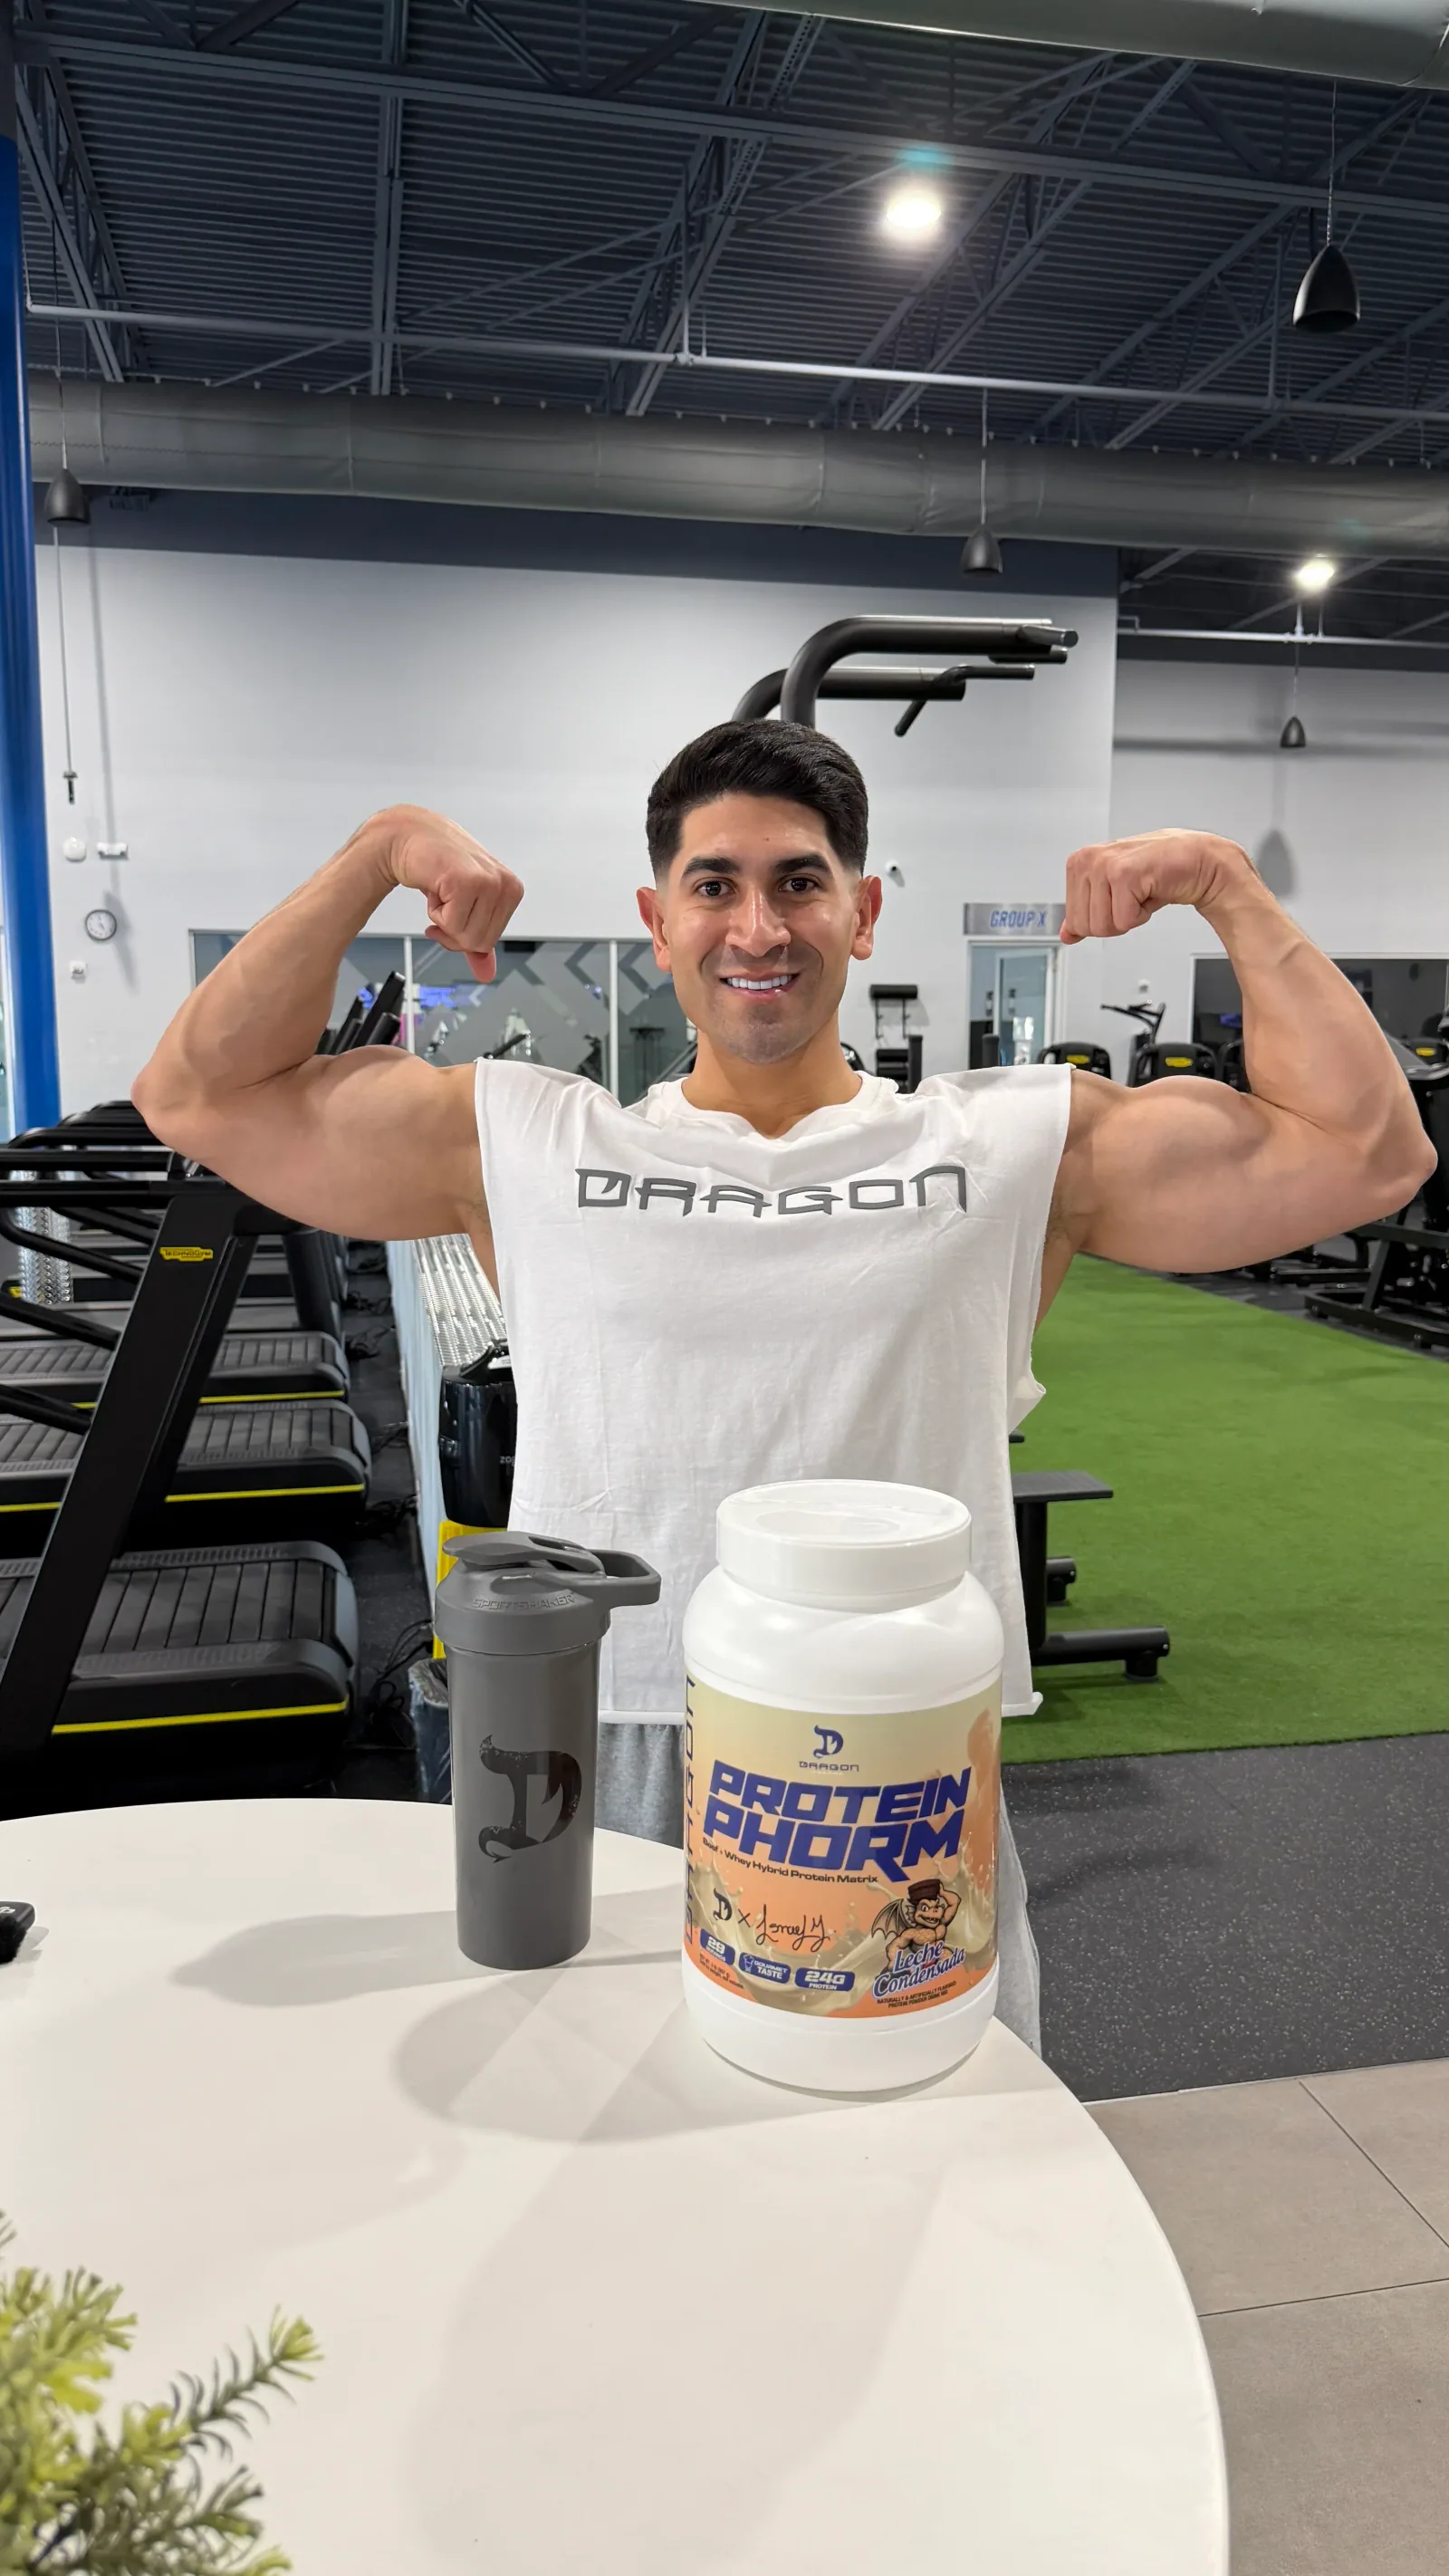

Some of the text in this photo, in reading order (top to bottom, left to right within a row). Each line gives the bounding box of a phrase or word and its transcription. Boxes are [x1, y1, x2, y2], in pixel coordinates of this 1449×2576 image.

[989, 910, 1047, 928] GROUP X
[575, 1165, 967, 1217] DRAGON
[473, 1595, 575, 1610] SPORTSHAKER
[799, 1761, 859, 1772] DRAGON
[709, 1759, 972, 1824] PROTEIN
[703, 1794, 964, 1883] PHORM
[703, 1837, 718, 1852] Beef
[724, 1850, 751, 1869] Whey
[753, 1861, 789, 1877] Hybrid
[791, 1870, 834, 1882] Protein
[837, 1875, 878, 1883] Matrix
[707, 1936, 725, 1955] 29
[894, 1940, 945, 1973] Leche
[753, 1960, 788, 1974] GOURMET
[757, 1966, 782, 1980] TASTE
[873, 1946, 964, 1998] Condensada
[804, 1970, 846, 1985] 24G
[809, 1983, 837, 1991] PROTEIN
